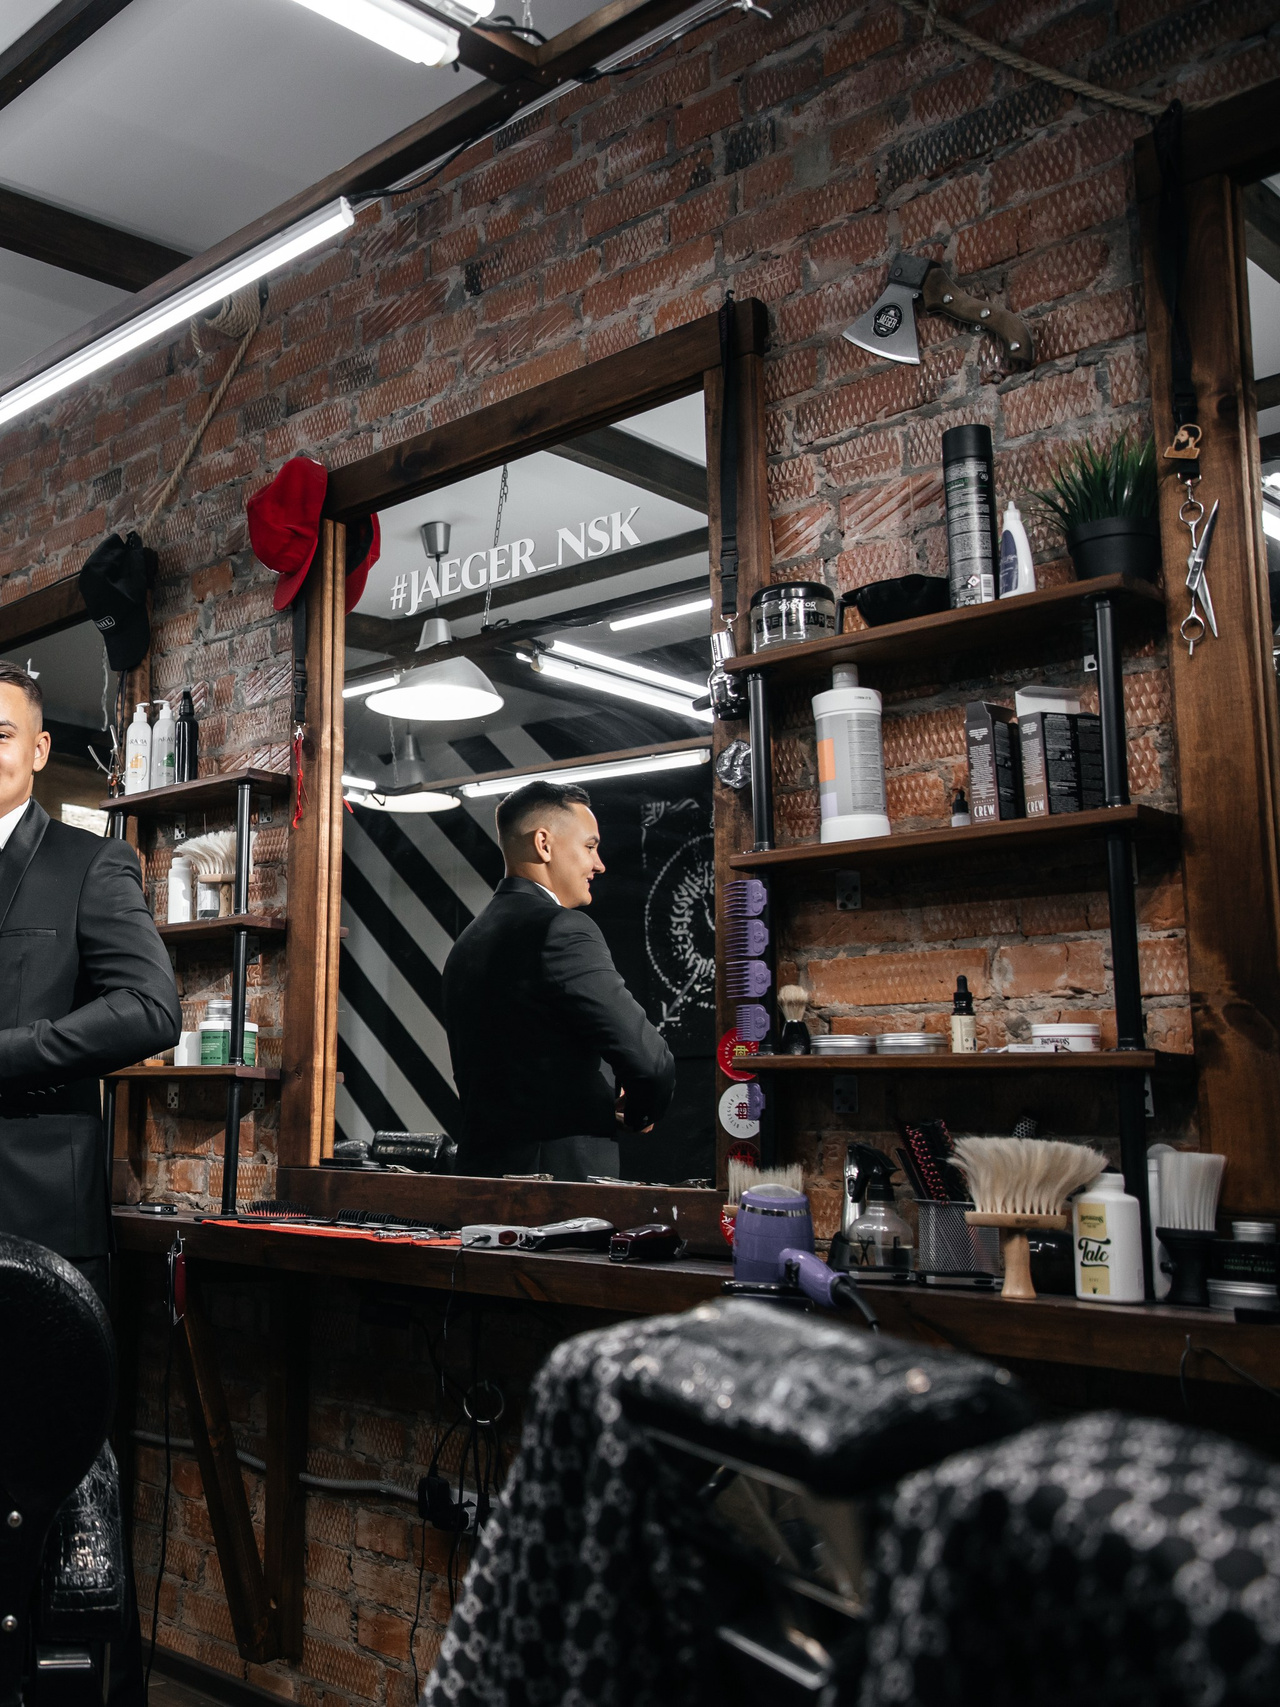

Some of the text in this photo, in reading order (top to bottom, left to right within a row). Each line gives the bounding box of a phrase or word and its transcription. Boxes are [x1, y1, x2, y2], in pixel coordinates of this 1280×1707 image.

[877, 313, 898, 329] JAEGER
[390, 505, 641, 616] #JAEGER_NSK
[973, 804, 995, 818] CREW
[1027, 800, 1045, 814] CREW
[1078, 1237, 1111, 1263] Talc
